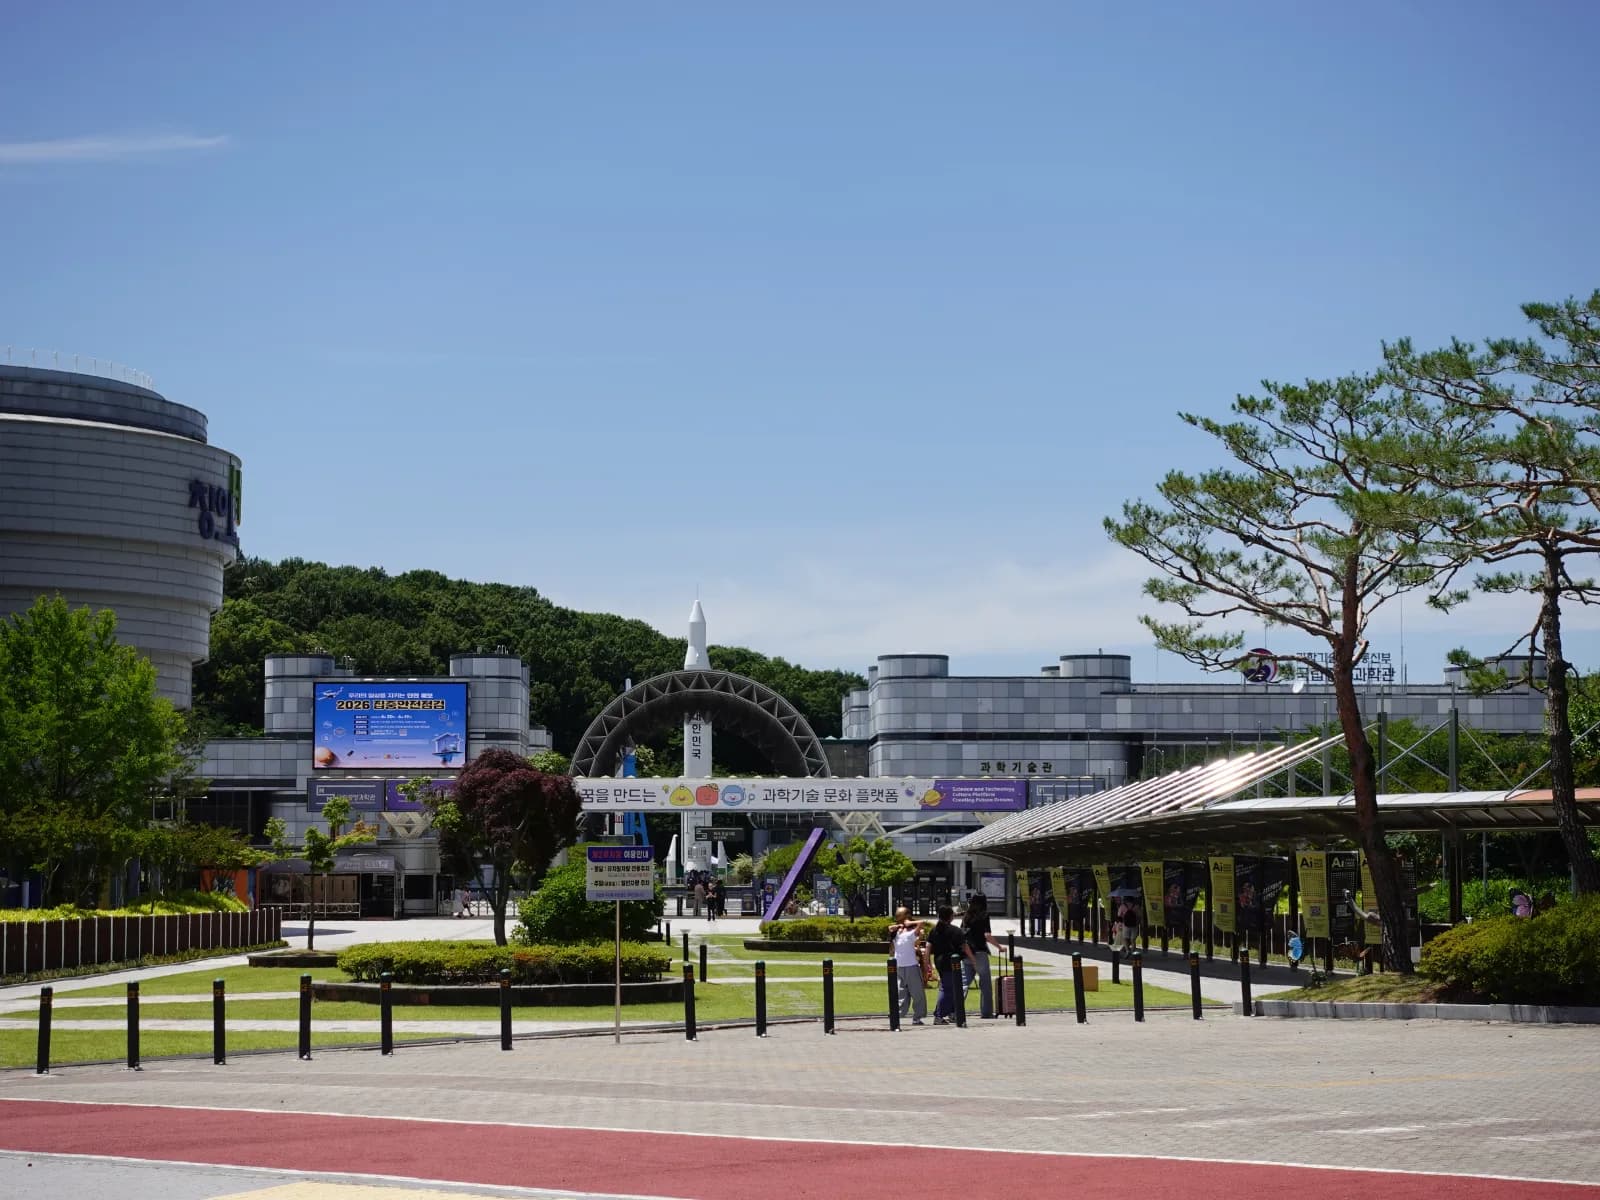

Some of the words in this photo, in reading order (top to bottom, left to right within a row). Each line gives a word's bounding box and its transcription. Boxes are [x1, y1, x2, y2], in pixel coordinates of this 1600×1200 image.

[336, 700, 370, 711] 2026
[980, 761, 1053, 774] 과학기술관
[581, 788, 609, 803] 꿈을
[613, 788, 657, 803] 만드는
[762, 788, 820, 803] 과학기술
[823, 788, 852, 803] 문화
[855, 788, 899, 803] 플랫폼
[623, 850, 649, 859] 이용안내
[1300, 857, 1313, 868] Ai
